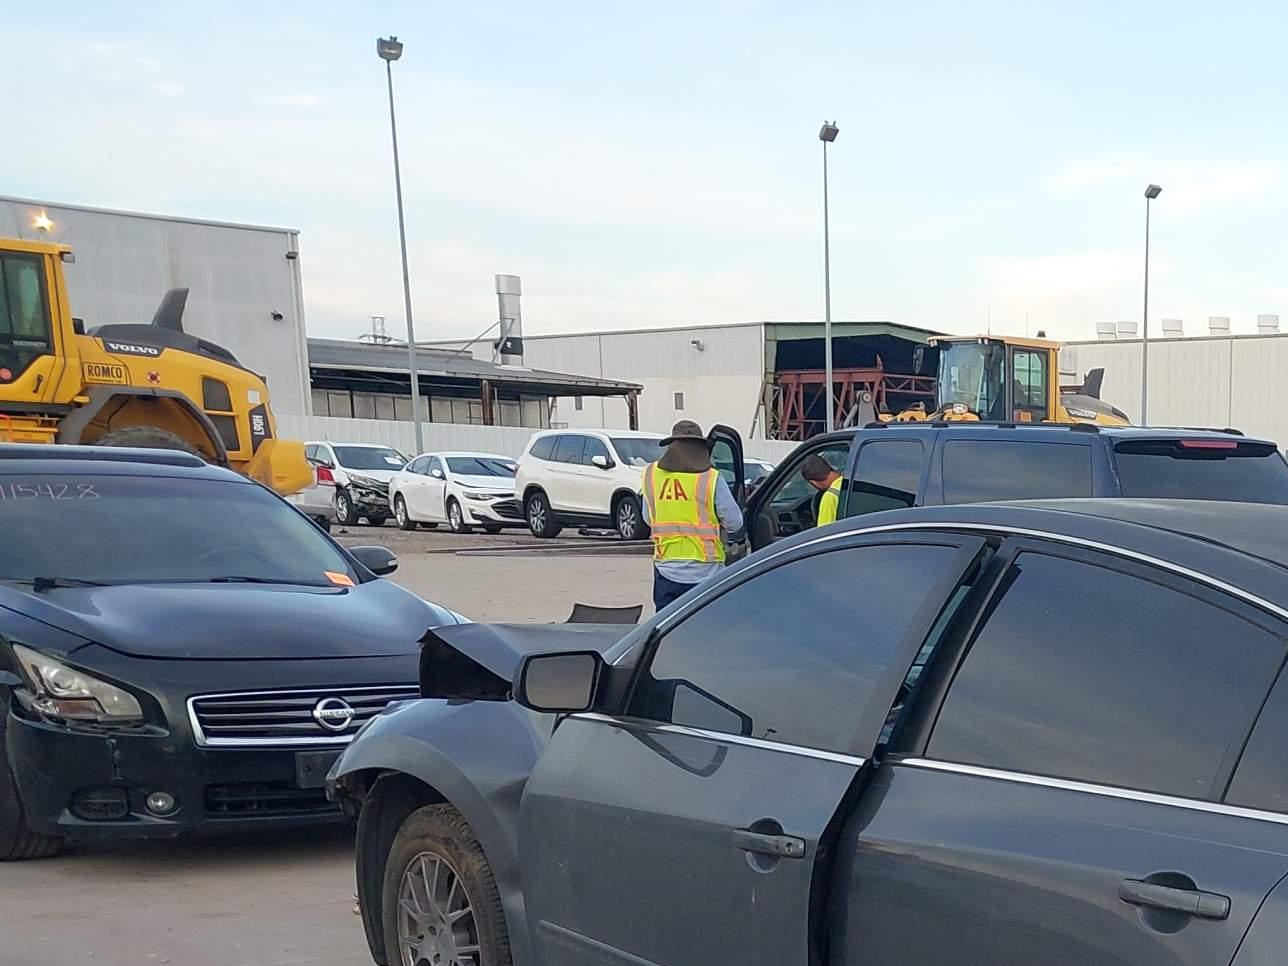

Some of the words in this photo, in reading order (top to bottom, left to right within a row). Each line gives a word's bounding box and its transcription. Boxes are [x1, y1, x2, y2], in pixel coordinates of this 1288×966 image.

[106, 342, 159, 355] VOLVO
[87, 364, 123, 379] ROMCO
[252, 414, 265, 436] L90H
